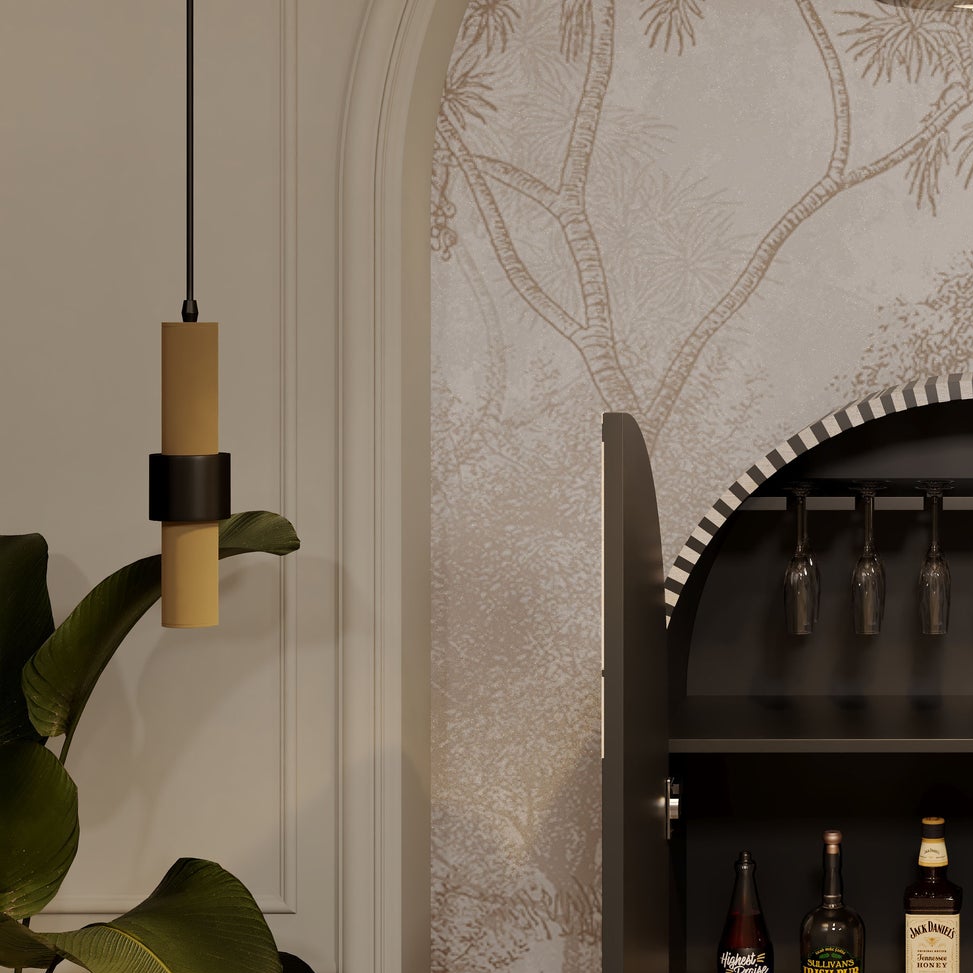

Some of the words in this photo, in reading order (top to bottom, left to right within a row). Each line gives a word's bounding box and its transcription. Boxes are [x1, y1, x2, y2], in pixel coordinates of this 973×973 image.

[909, 924, 927, 939] JACK
[928, 920, 956, 939] DANIEL'S
[720, 951, 757, 970] Highest
